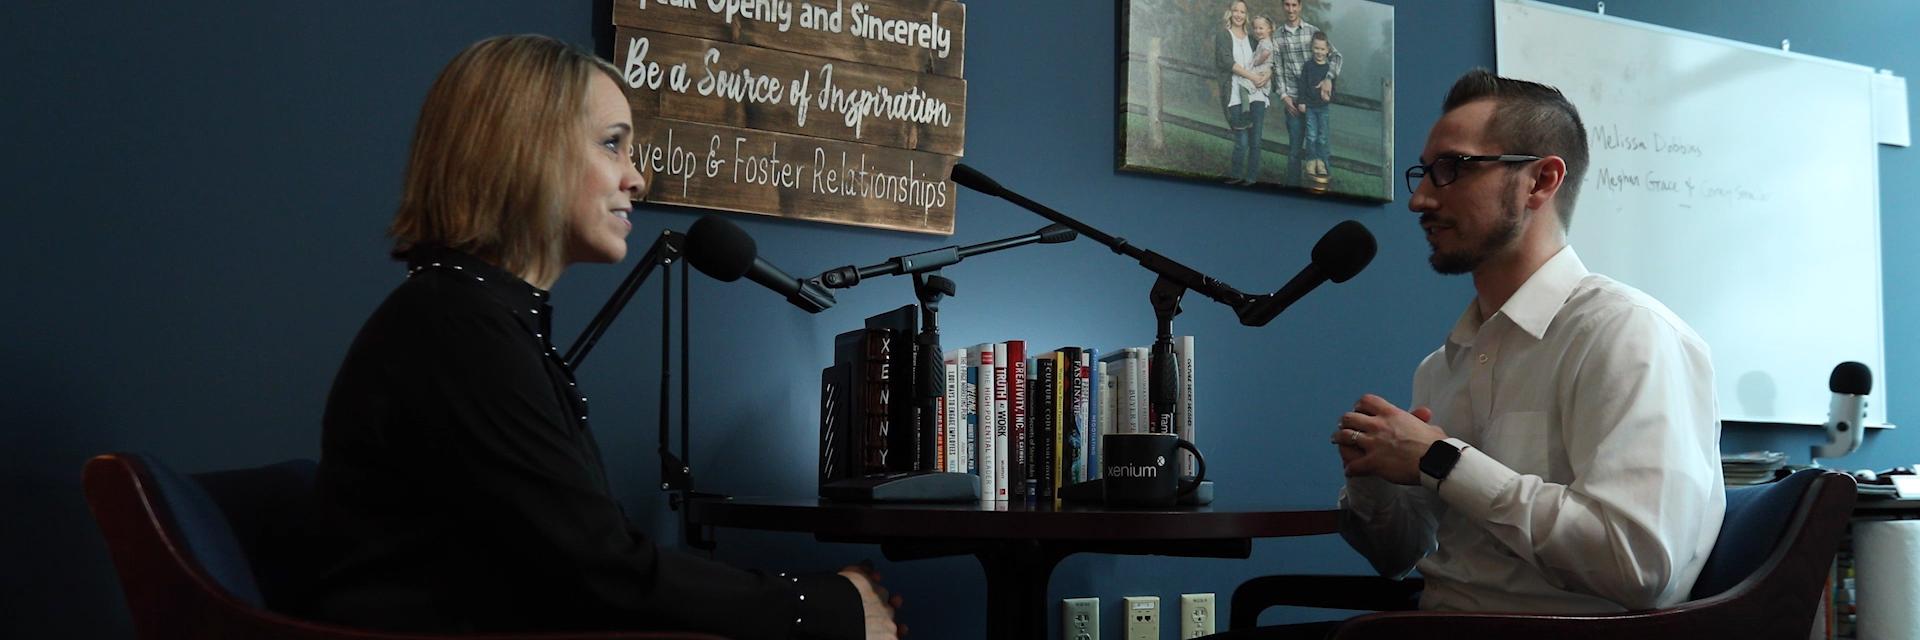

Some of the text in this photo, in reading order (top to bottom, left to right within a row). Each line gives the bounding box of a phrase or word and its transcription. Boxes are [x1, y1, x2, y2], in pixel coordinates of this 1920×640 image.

[800, 3, 843, 33] and
[850, 3, 951, 59] Sincerely
[624, 36, 952, 140] Be a Source of Inspiration
[1591, 124, 1647, 151] Melissa
[706, 134, 725, 178] &
[733, 137, 804, 190] Foster
[813, 147, 946, 225] Relationships
[996, 368, 1006, 400] TRUTH
[1015, 362, 1024, 431] CREATIVITY, INC.
[1073, 360, 1081, 415] FASCINATE
[997, 410, 1006, 437] WORK
[1107, 463, 1156, 478] xenium
